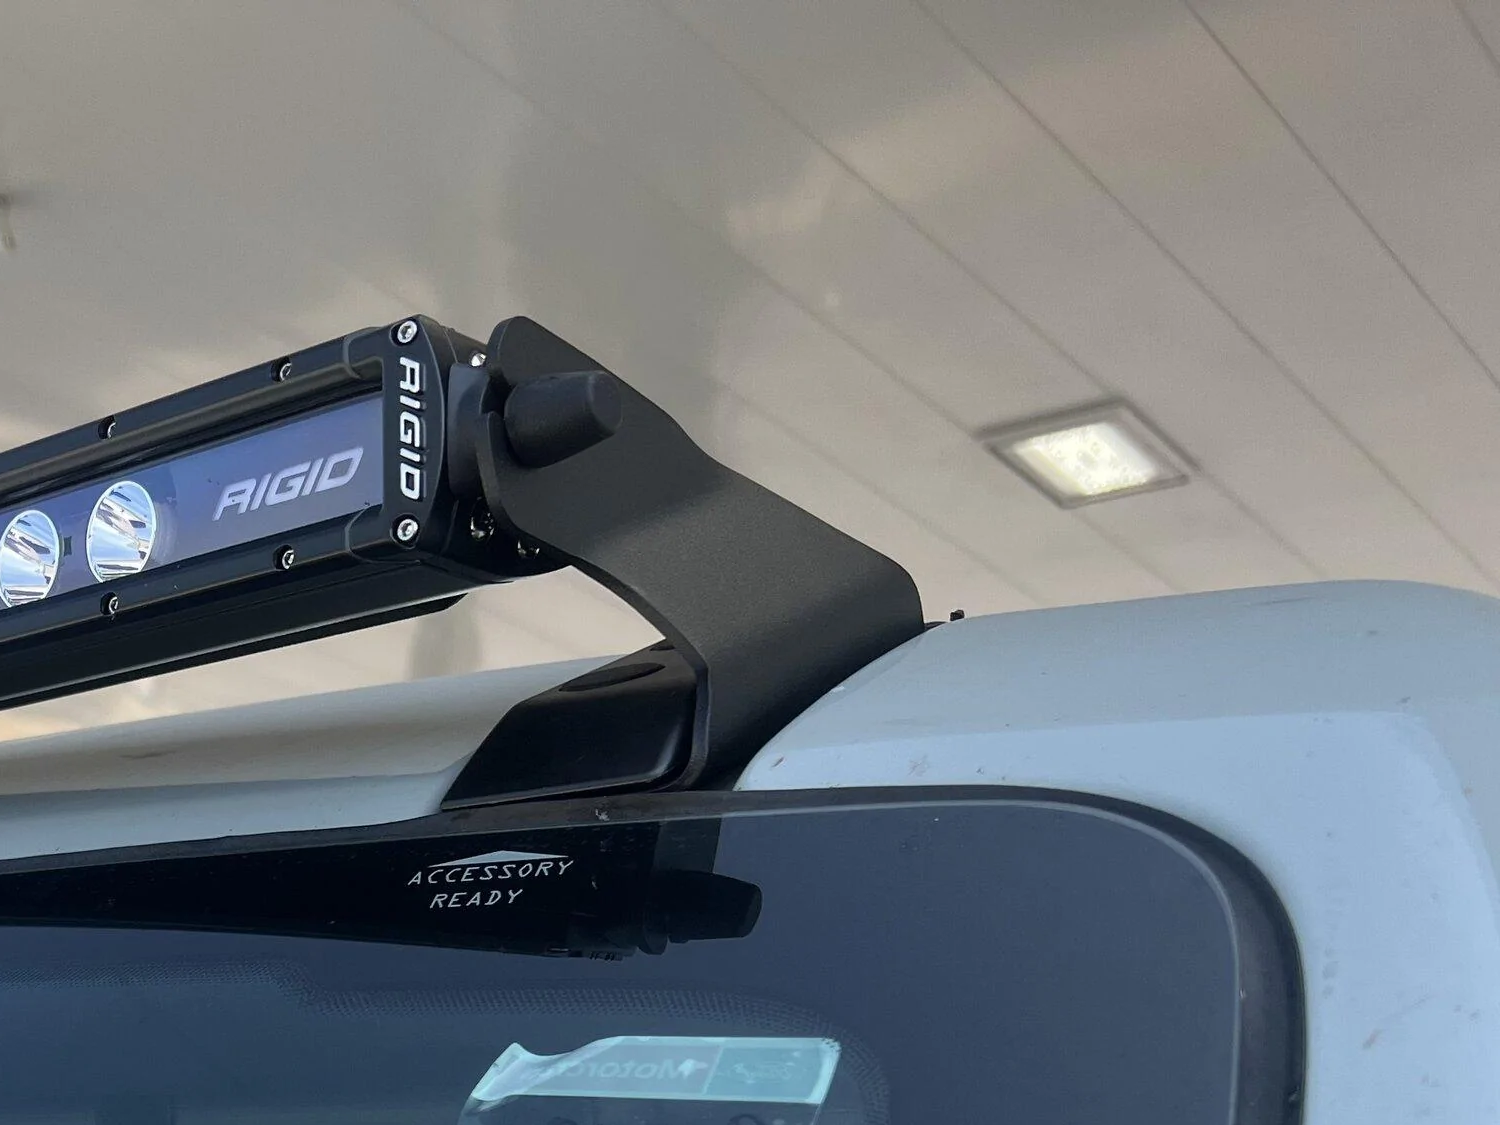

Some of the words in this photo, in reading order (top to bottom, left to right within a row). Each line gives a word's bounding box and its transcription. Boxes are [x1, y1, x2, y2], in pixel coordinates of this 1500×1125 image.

[400, 356, 426, 501] RIGID
[212, 447, 364, 521] RIGID
[408, 860, 574, 886] ACCESSORY
[429, 888, 523, 909] READY
